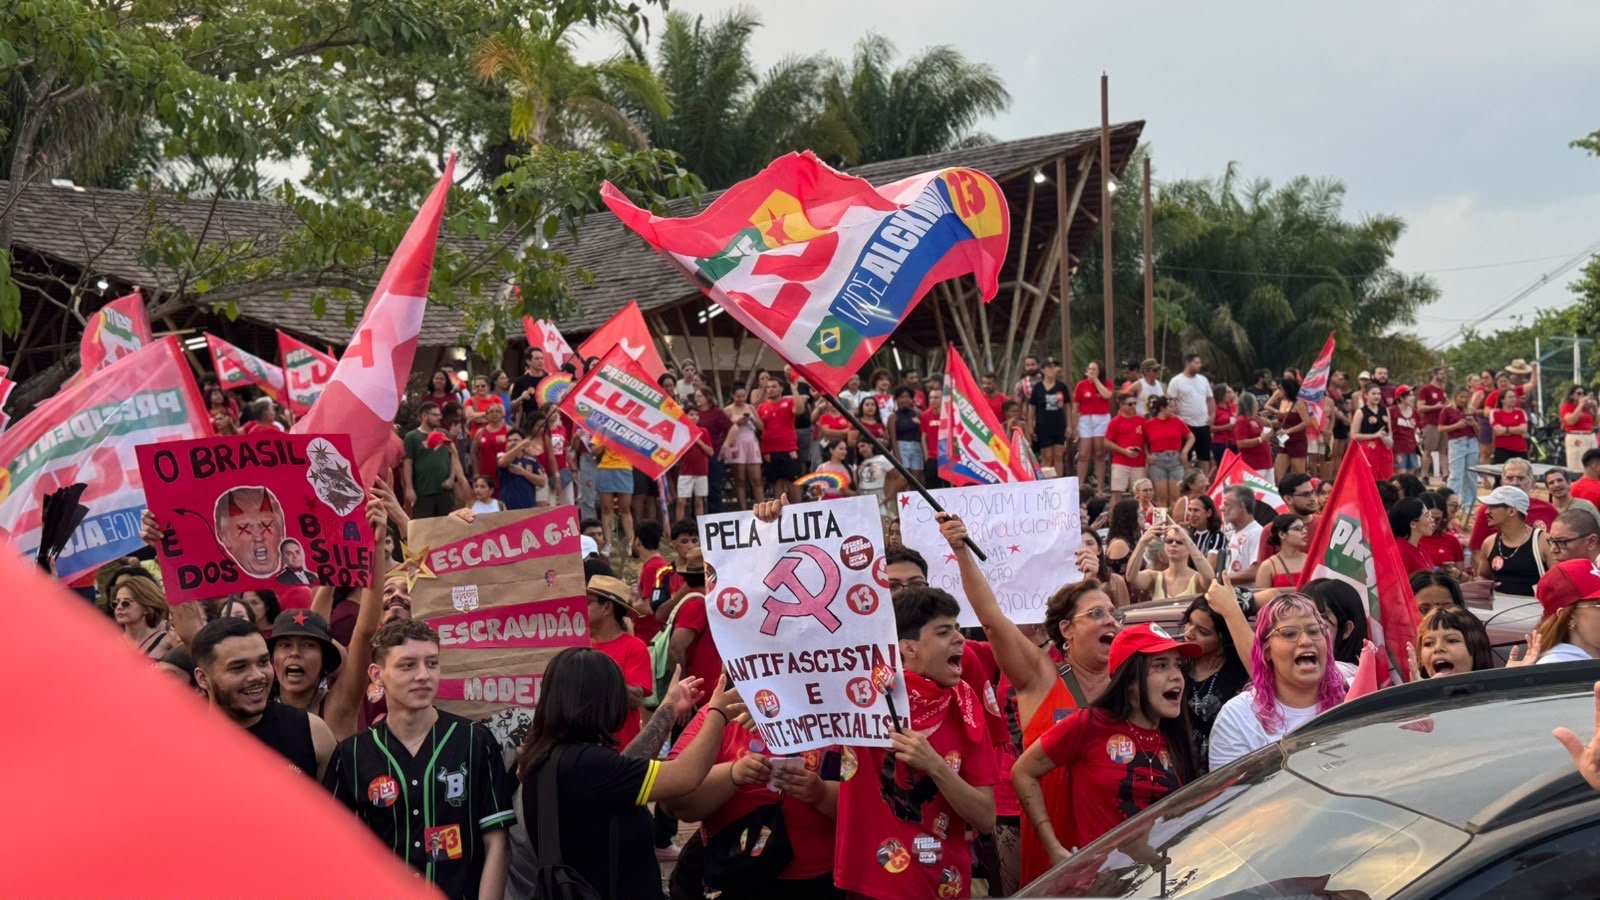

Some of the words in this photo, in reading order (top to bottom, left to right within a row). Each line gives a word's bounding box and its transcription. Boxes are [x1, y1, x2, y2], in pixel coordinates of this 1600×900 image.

[946, 171, 985, 219] 13
[836, 272, 887, 326] VICE
[600, 364, 664, 403] PRESIDENTE
[583, 380, 676, 443] LULA
[604, 419, 656, 450] ALCKMIN
[153, 449, 179, 483] O
[189, 439, 306, 479] BRASIL
[160, 522, 183, 557] É
[705, 518, 761, 551] PELA
[777, 509, 843, 544] LUTA
[430, 528, 541, 572] ESCALA
[177, 559, 239, 590] DOS
[722, 592, 744, 612] 13
[850, 586, 874, 611] 13
[438, 606, 587, 645] ESCRAVIDÃO
[463, 676, 542, 705] MODE
[805, 682, 824, 705] E
[850, 679, 873, 704] 13
[447, 773, 464, 799] B
